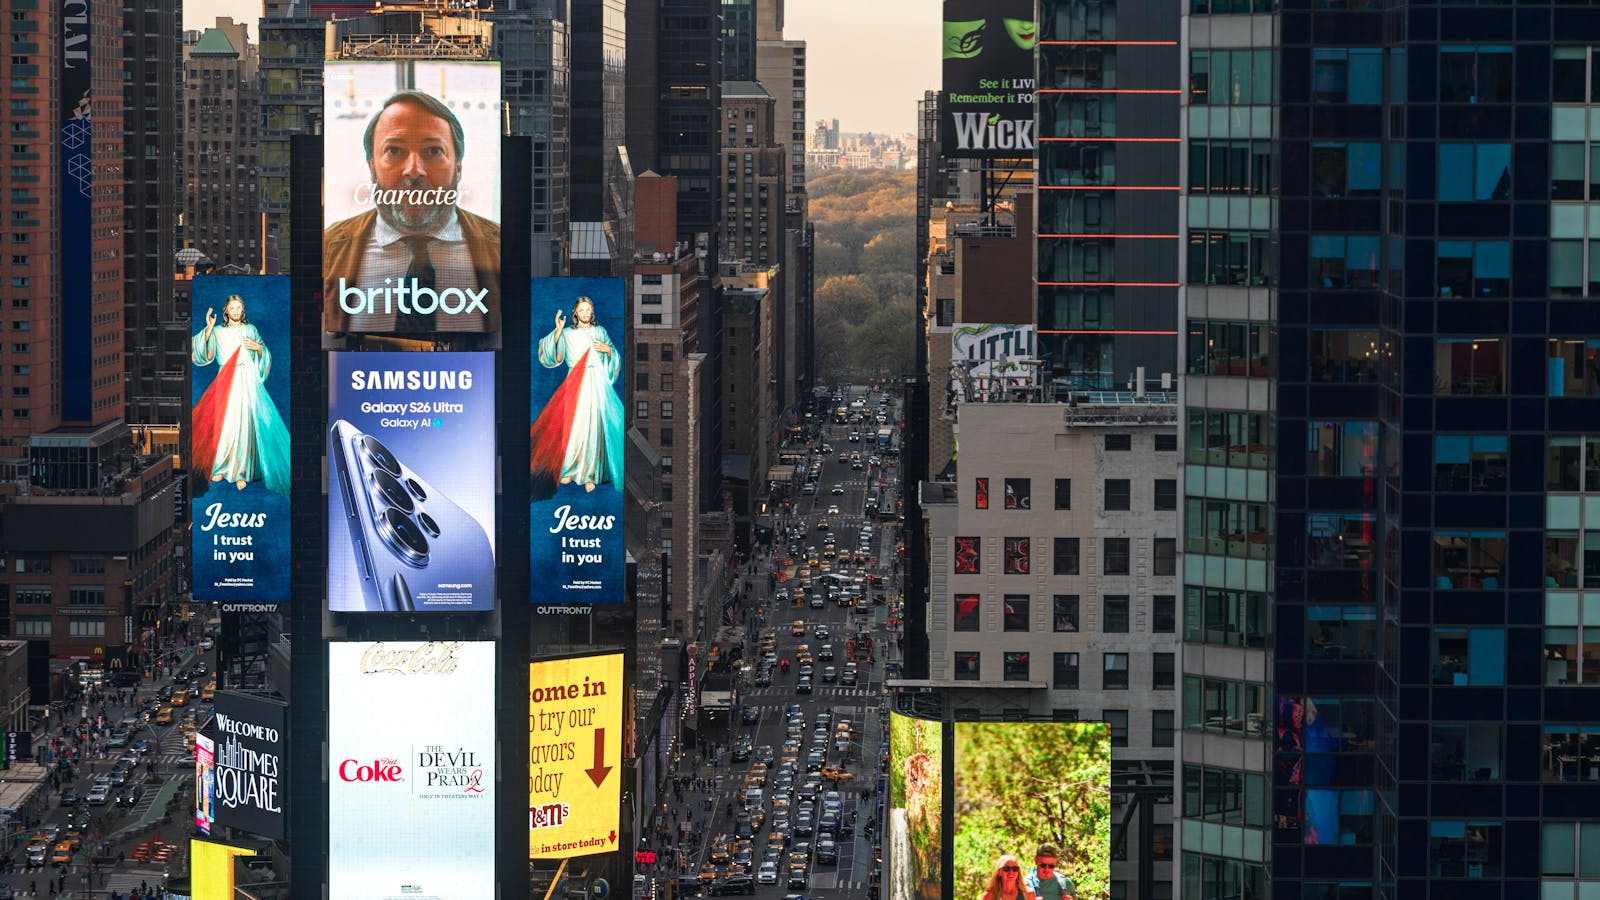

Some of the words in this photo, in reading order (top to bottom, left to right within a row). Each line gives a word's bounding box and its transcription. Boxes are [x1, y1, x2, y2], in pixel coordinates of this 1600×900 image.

[979, 79, 999, 88] See
[1001, 78, 1009, 88] it
[949, 93, 1005, 103] Remember
[1007, 93, 1015, 103] it
[353, 182, 470, 207] Character
[338, 277, 489, 316] britbox
[351, 370, 473, 390] SAMSUNG
[360, 401, 407, 415] Galaxy
[409, 402, 431, 414] S26
[433, 402, 463, 414] Ultra
[380, 417, 418, 430] Galaxy
[200, 503, 267, 532] Jesus
[549, 505, 616, 534] Jesus
[213, 535, 218, 546] I
[220, 535, 253, 546] trust
[562, 537, 566, 548] I
[569, 537, 601, 548] trust
[213, 550, 227, 561] in
[229, 553, 254, 564] you
[562, 552, 575, 563] in
[577, 555, 603, 566] you
[529, 684, 579, 703] ome
[582, 676, 606, 697] in
[539, 708, 565, 736] try
[569, 707, 596, 728] our
[264, 728, 279, 743] TO
[8, 732, 17, 760] GIFTS
[241, 748, 279, 778] TIMES
[419, 747, 482, 767] DEVIL
[338, 758, 402, 782] Coke
[427, 771, 481, 786] PRADA
[464, 769, 485, 793] 2
[541, 844, 551, 853] in
[552, 841, 578, 851] store
[579, 837, 606, 848] today
